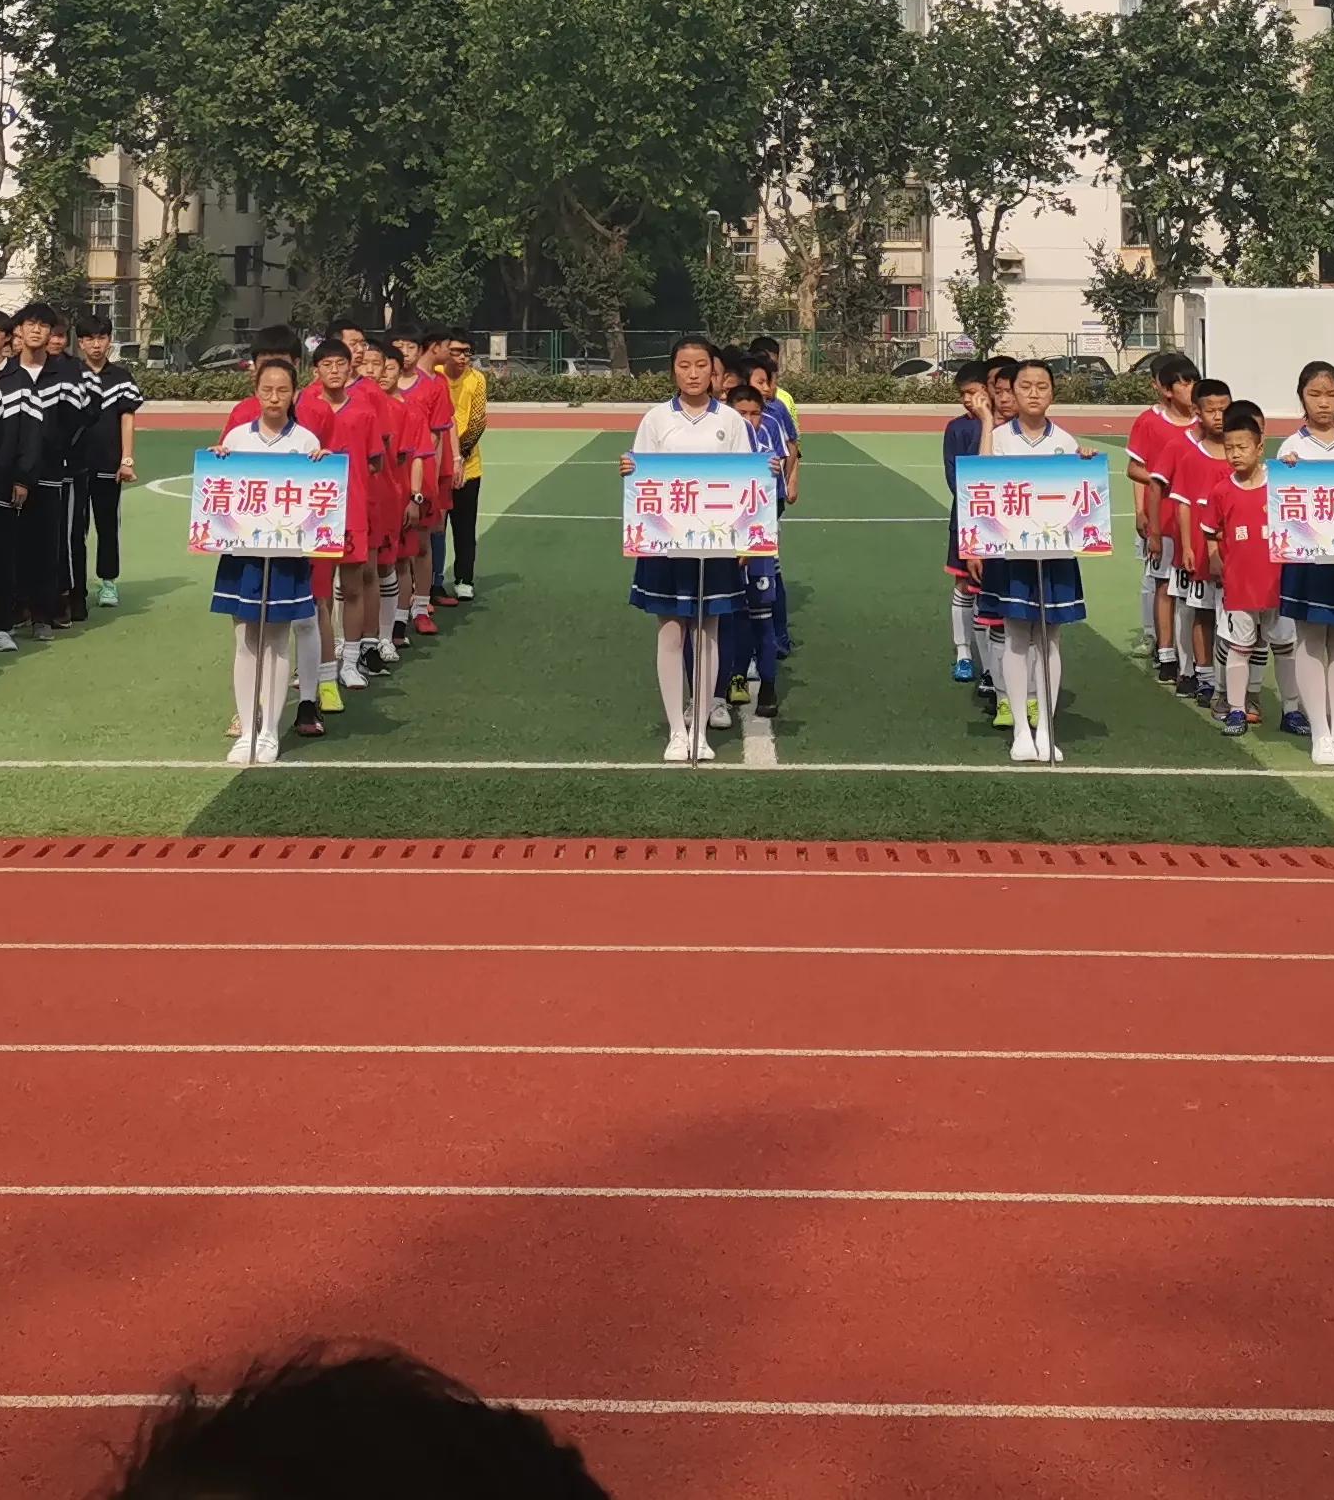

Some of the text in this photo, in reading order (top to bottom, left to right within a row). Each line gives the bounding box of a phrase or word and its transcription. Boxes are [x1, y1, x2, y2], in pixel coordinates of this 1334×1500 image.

[201, 477, 339, 517] 清源中学
[634, 478, 768, 516] 高新二小
[969, 481, 1101, 518] 高新一小
[1175, 569, 1189, 589] 18
[1189, 580, 1204, 599] 10
